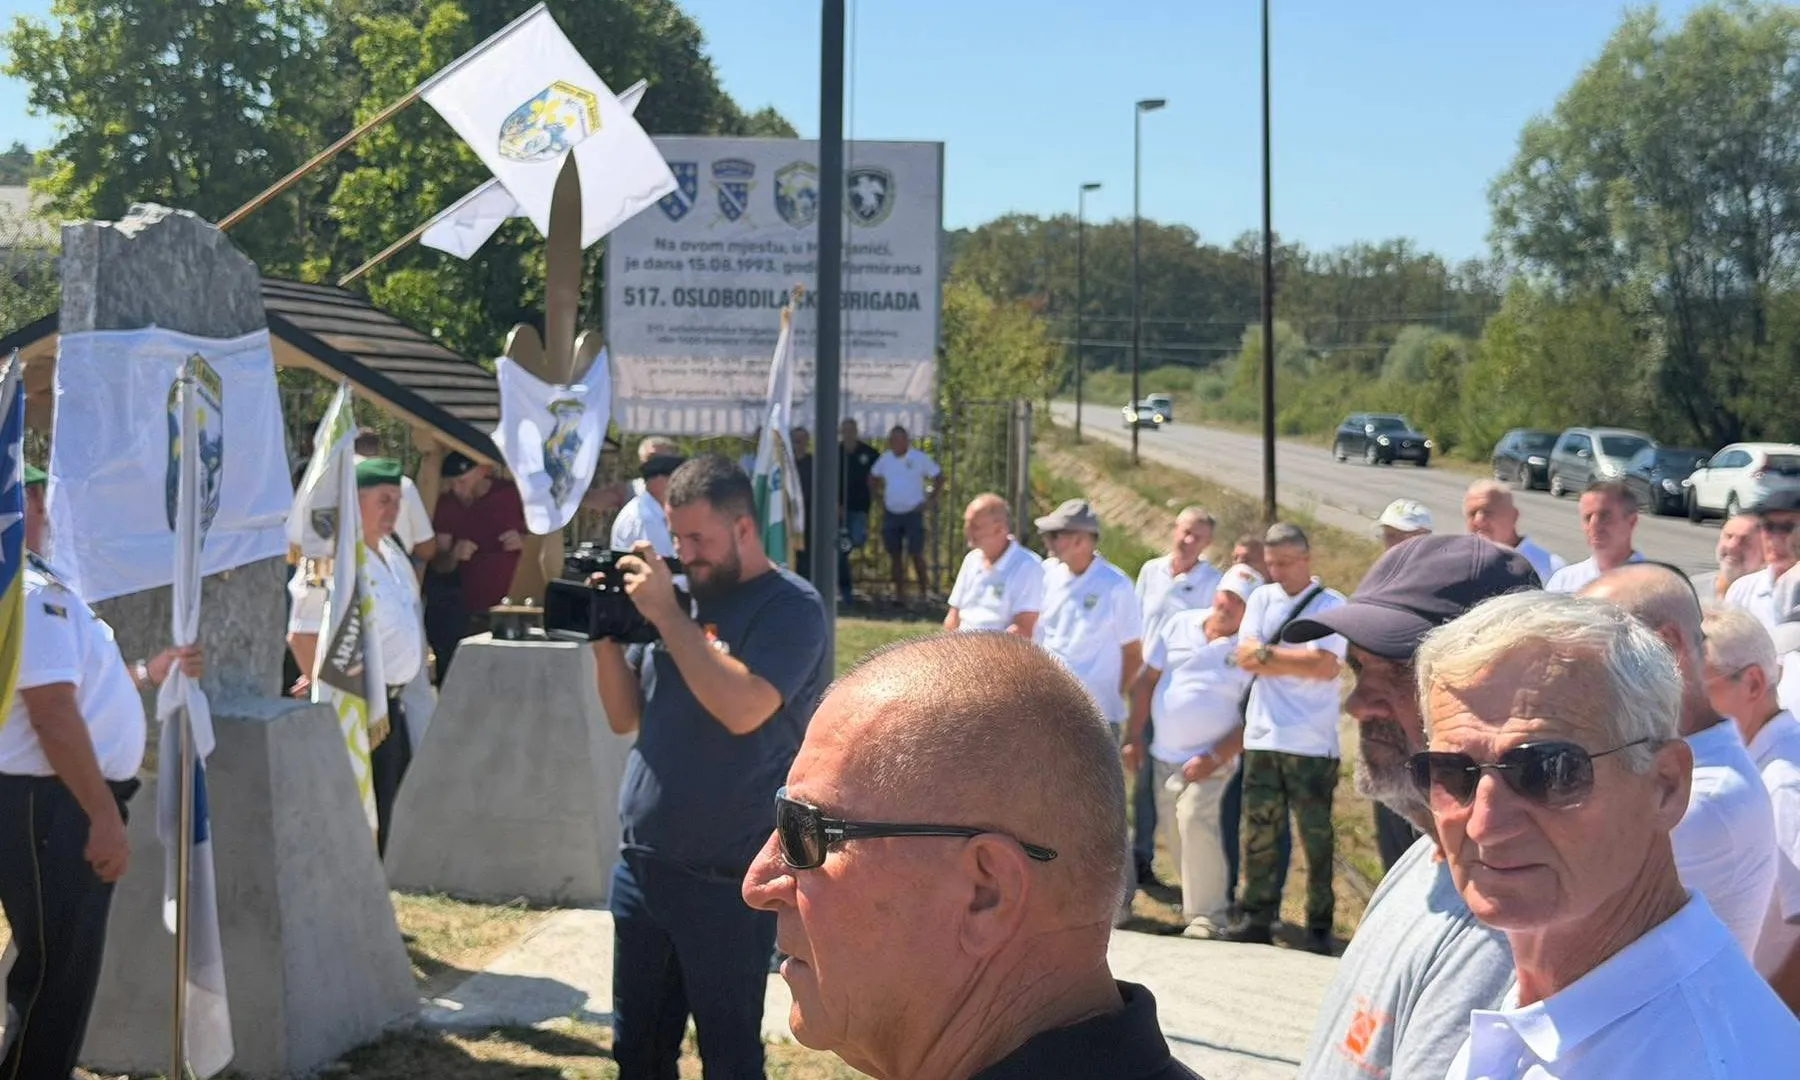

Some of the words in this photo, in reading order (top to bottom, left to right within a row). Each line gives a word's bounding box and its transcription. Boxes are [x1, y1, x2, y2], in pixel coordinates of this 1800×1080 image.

[654, 238, 676, 252] Na
[680, 240, 724, 253] ovom
[728, 240, 788, 256] mjestu,
[792, 243, 803, 254] u
[624, 256, 640, 273] je
[643, 256, 684, 271] dana
[688, 257, 778, 273] 15.08.1993.
[623, 286, 666, 307] 517.
[672, 287, 819, 309] OSLOBODILAK
